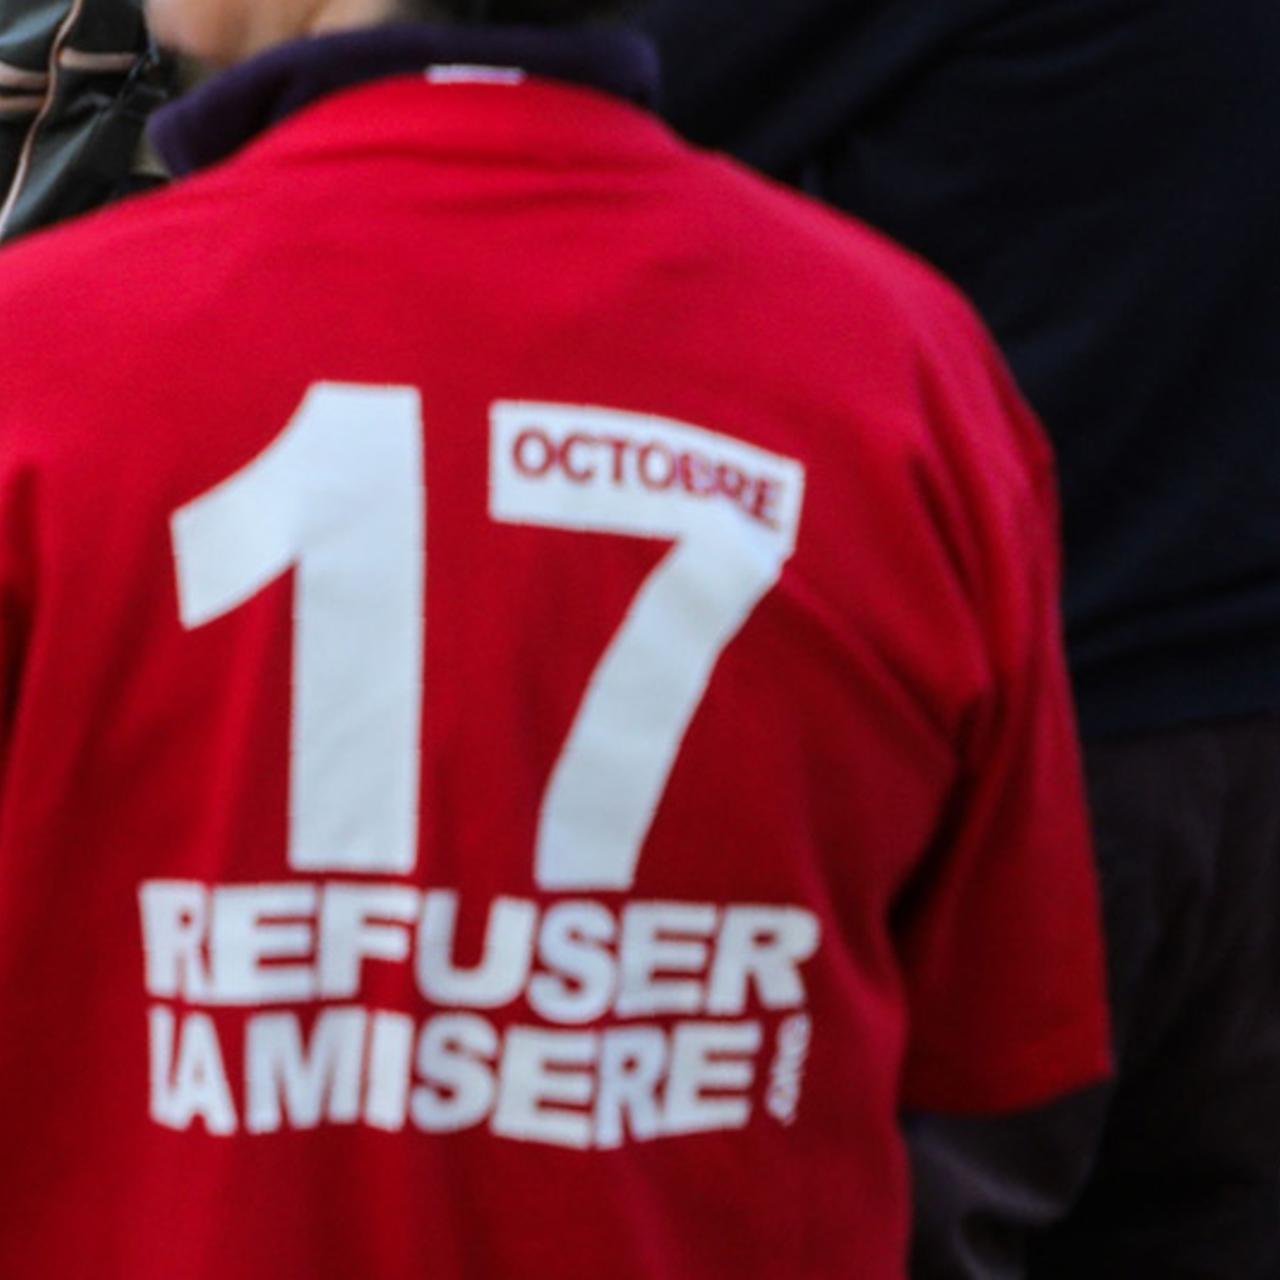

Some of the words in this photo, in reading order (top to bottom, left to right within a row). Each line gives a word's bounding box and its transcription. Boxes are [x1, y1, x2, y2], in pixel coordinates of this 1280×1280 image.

[512, 427, 781, 532] OCTOBRE
[170, 380, 806, 892] 17
[138, 878, 821, 1024] REFUSER
